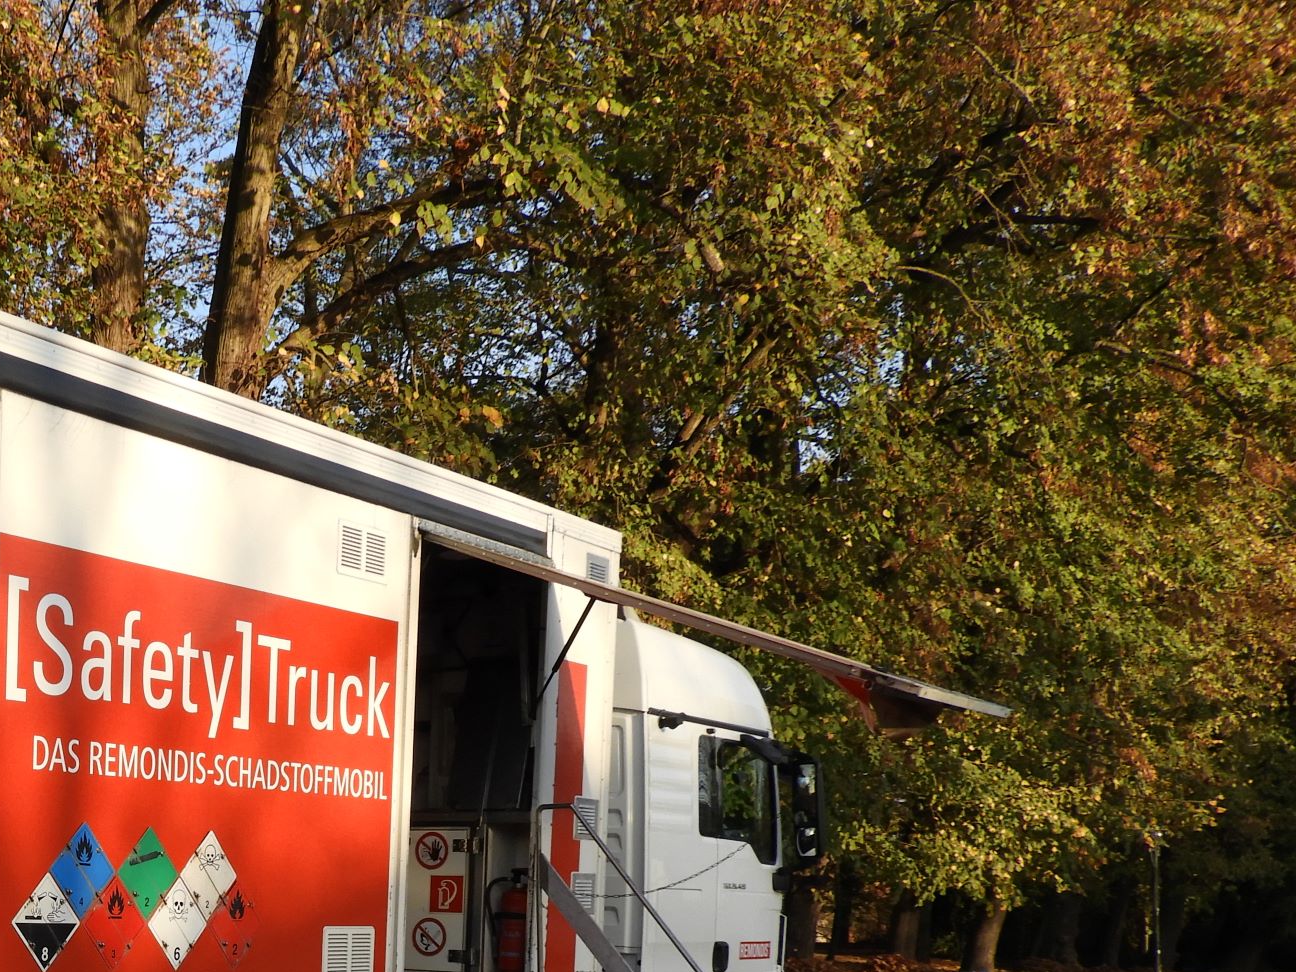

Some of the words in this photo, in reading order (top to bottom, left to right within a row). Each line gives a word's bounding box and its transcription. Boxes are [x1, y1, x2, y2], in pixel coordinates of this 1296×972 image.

[32, 735, 80, 773] DAS
[89, 741, 388, 800] REMONDIS-SCHADSTOFFMOBIL
[79, 897, 84, 906] 4
[144, 898, 150, 907] 2
[205, 900, 210, 908] 2
[111, 949, 116, 958] 3
[173, 947, 181, 961] 6
[232, 943, 238, 955] 2
[41, 947, 49, 962] 8
